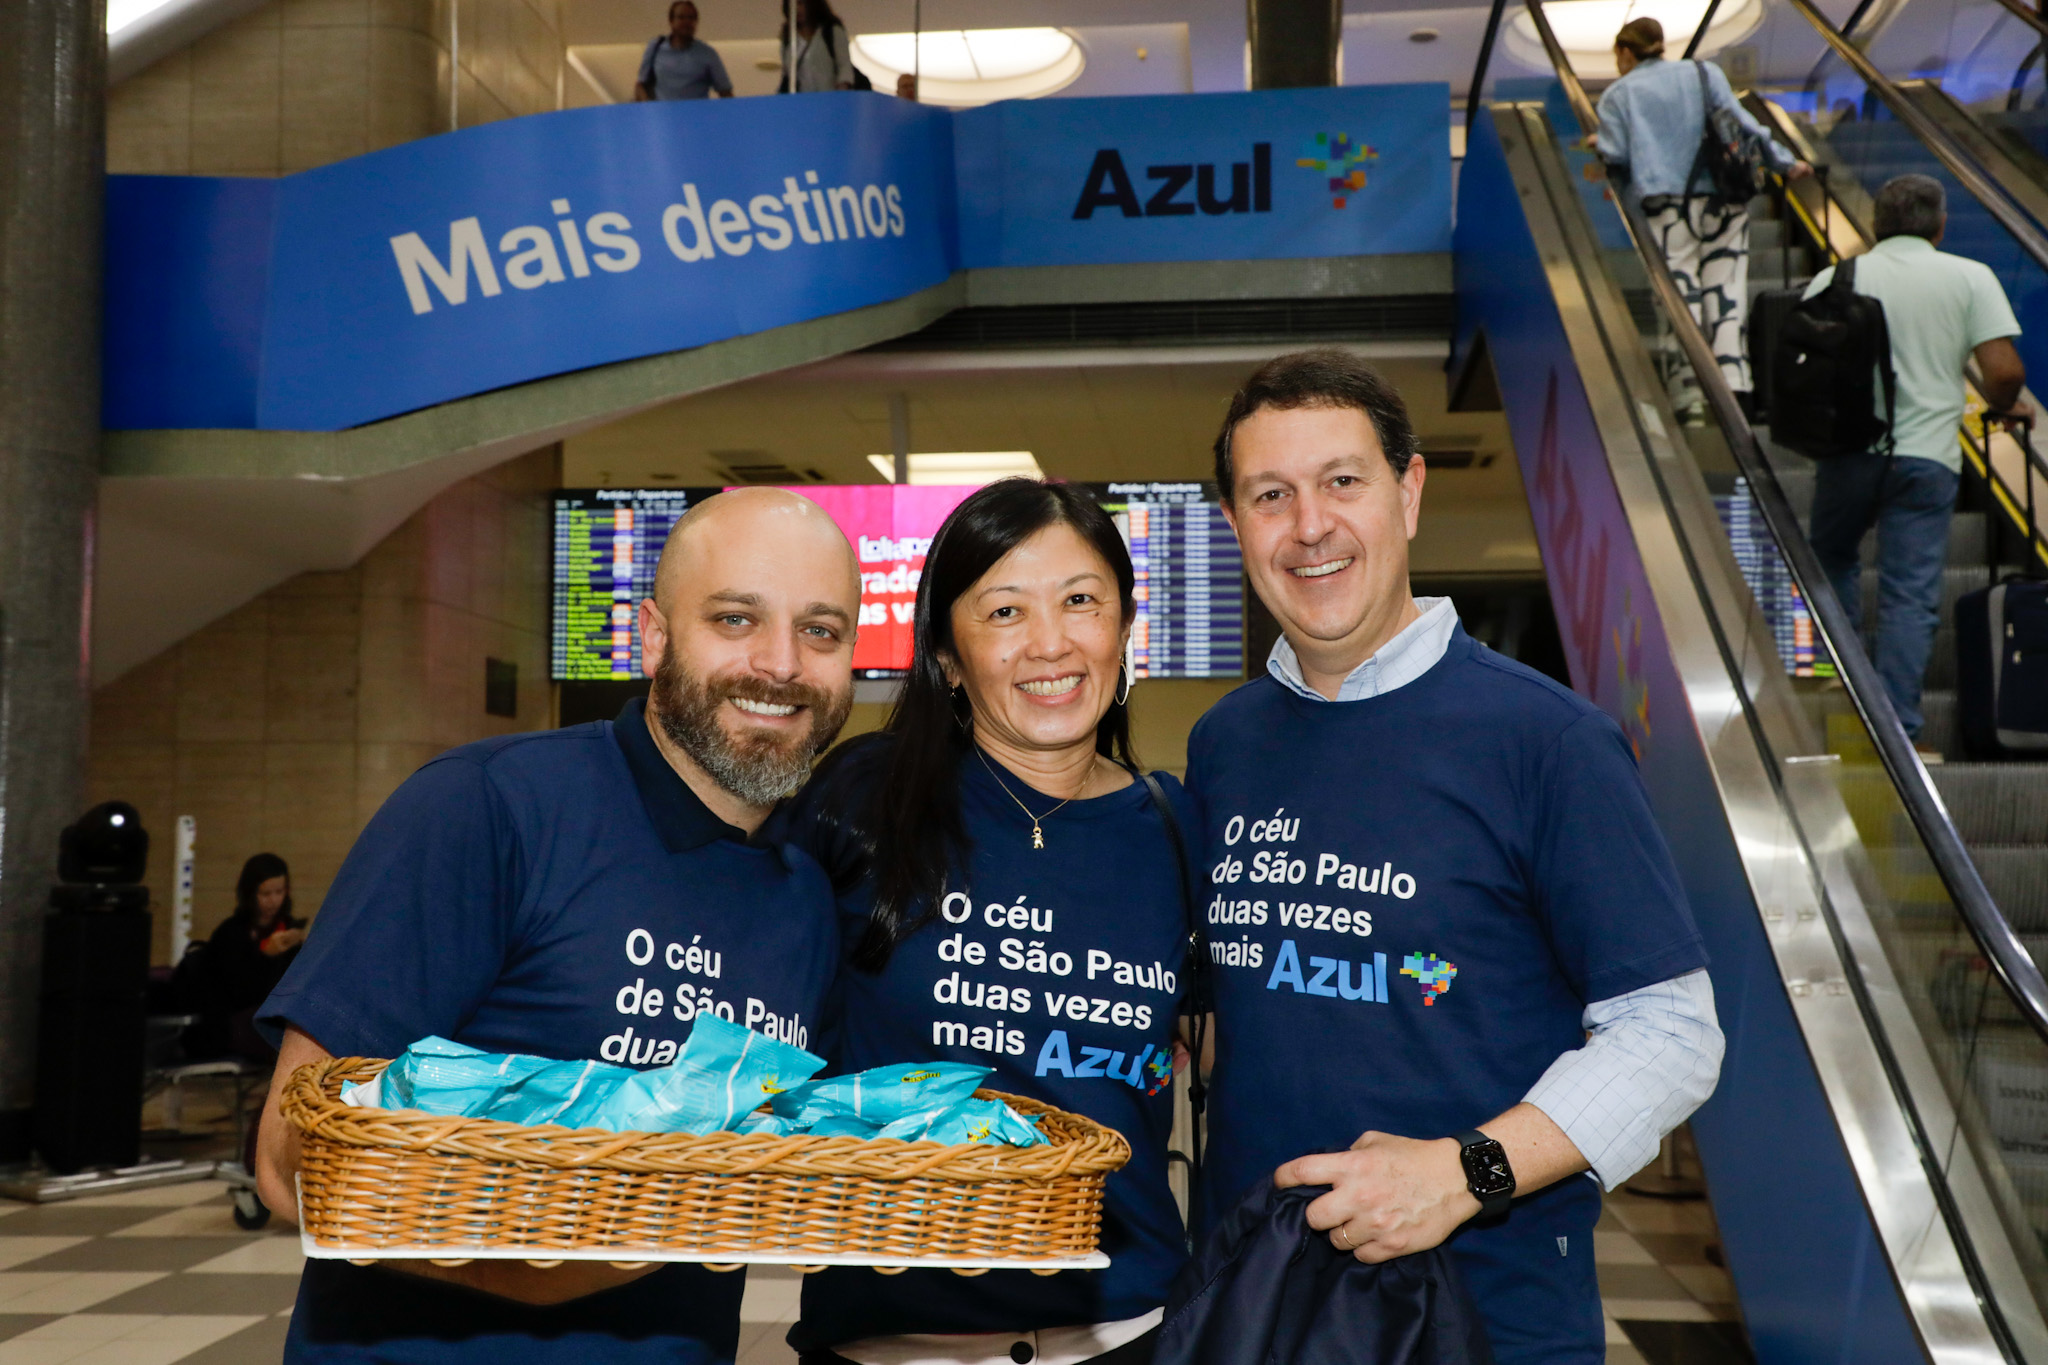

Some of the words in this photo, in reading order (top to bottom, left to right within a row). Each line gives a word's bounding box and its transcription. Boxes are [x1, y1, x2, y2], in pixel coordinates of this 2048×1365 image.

[1071, 142, 1272, 221] Azul
[389, 198, 641, 316] Mais
[662, 170, 905, 263] destinos
[1224, 815, 1245, 846] O
[1249, 807, 1300, 842] céu
[1211, 854, 1243, 884] de
[1249, 850, 1307, 884] São
[1315, 852, 1417, 900] Paulo
[941, 891, 972, 924] O
[983, 895, 1053, 932] céu
[1208, 893, 1268, 925] duas
[1278, 902, 1373, 937] vezes
[625, 928, 655, 966] O
[665, 934, 721, 979] céu
[937, 932, 987, 965] de
[998, 937, 1073, 976] São
[1086, 949, 1176, 995] Paulo
[1209, 935, 1264, 968] mais
[1266, 939, 1389, 1004] Azul
[615, 977, 664, 1017] de
[673, 983, 735, 1024] São
[745, 997, 808, 1050] Paulo
[933, 971, 1031, 1013] duas
[1044, 991, 1152, 1031] vezes
[599, 1026, 687, 1065] dua
[932, 1020, 1026, 1055] mais
[1034, 1029, 1155, 1090] Azul
